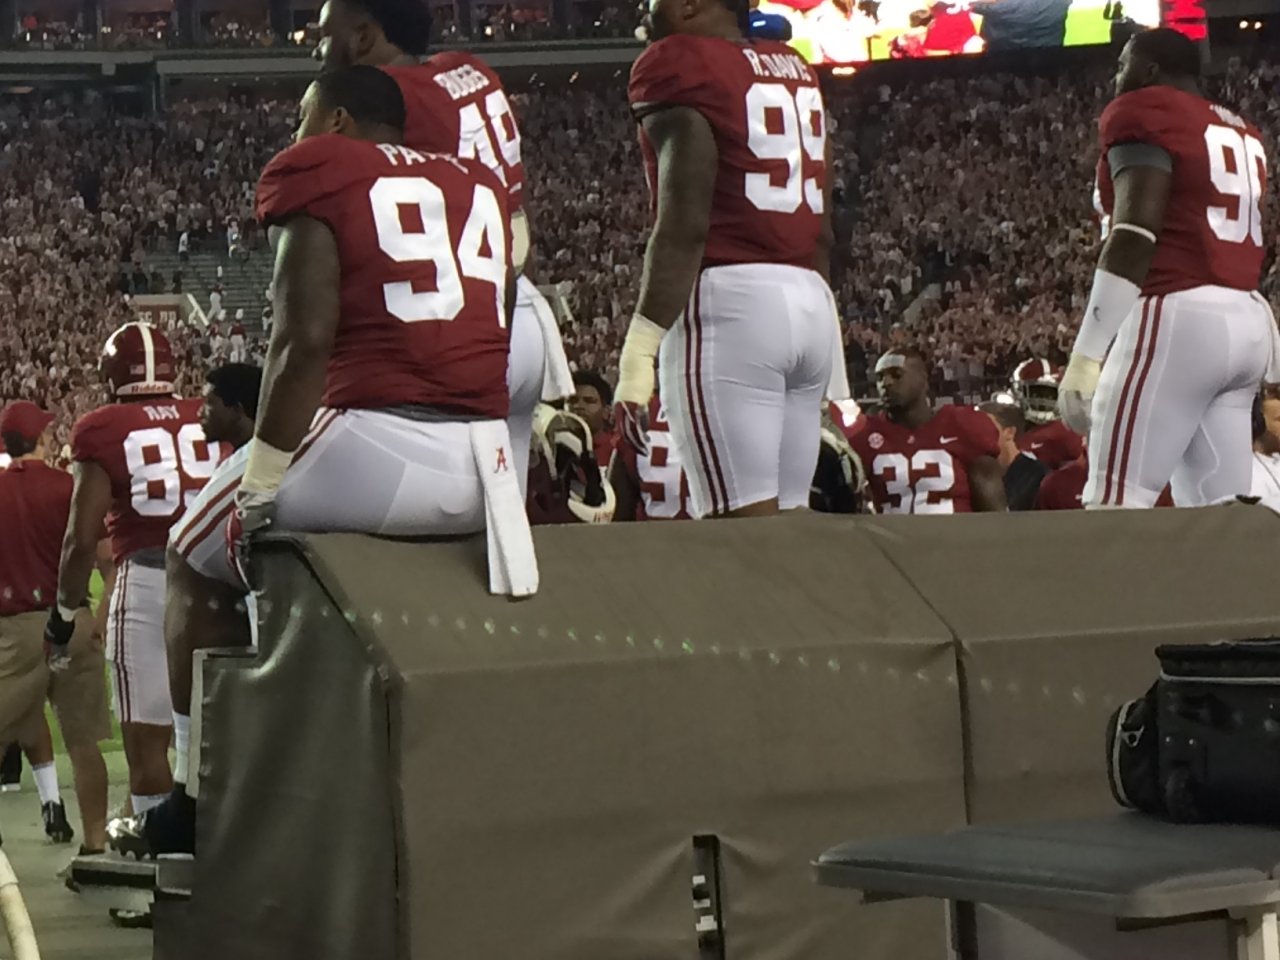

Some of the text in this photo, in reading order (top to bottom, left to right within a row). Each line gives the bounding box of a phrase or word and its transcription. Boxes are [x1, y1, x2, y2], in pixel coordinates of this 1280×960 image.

[744, 82, 826, 214] 99
[369, 176, 508, 329] 94
[142, 404, 180, 420] RAY
[123, 423, 220, 516] 89
[872, 449, 956, 514] 32
